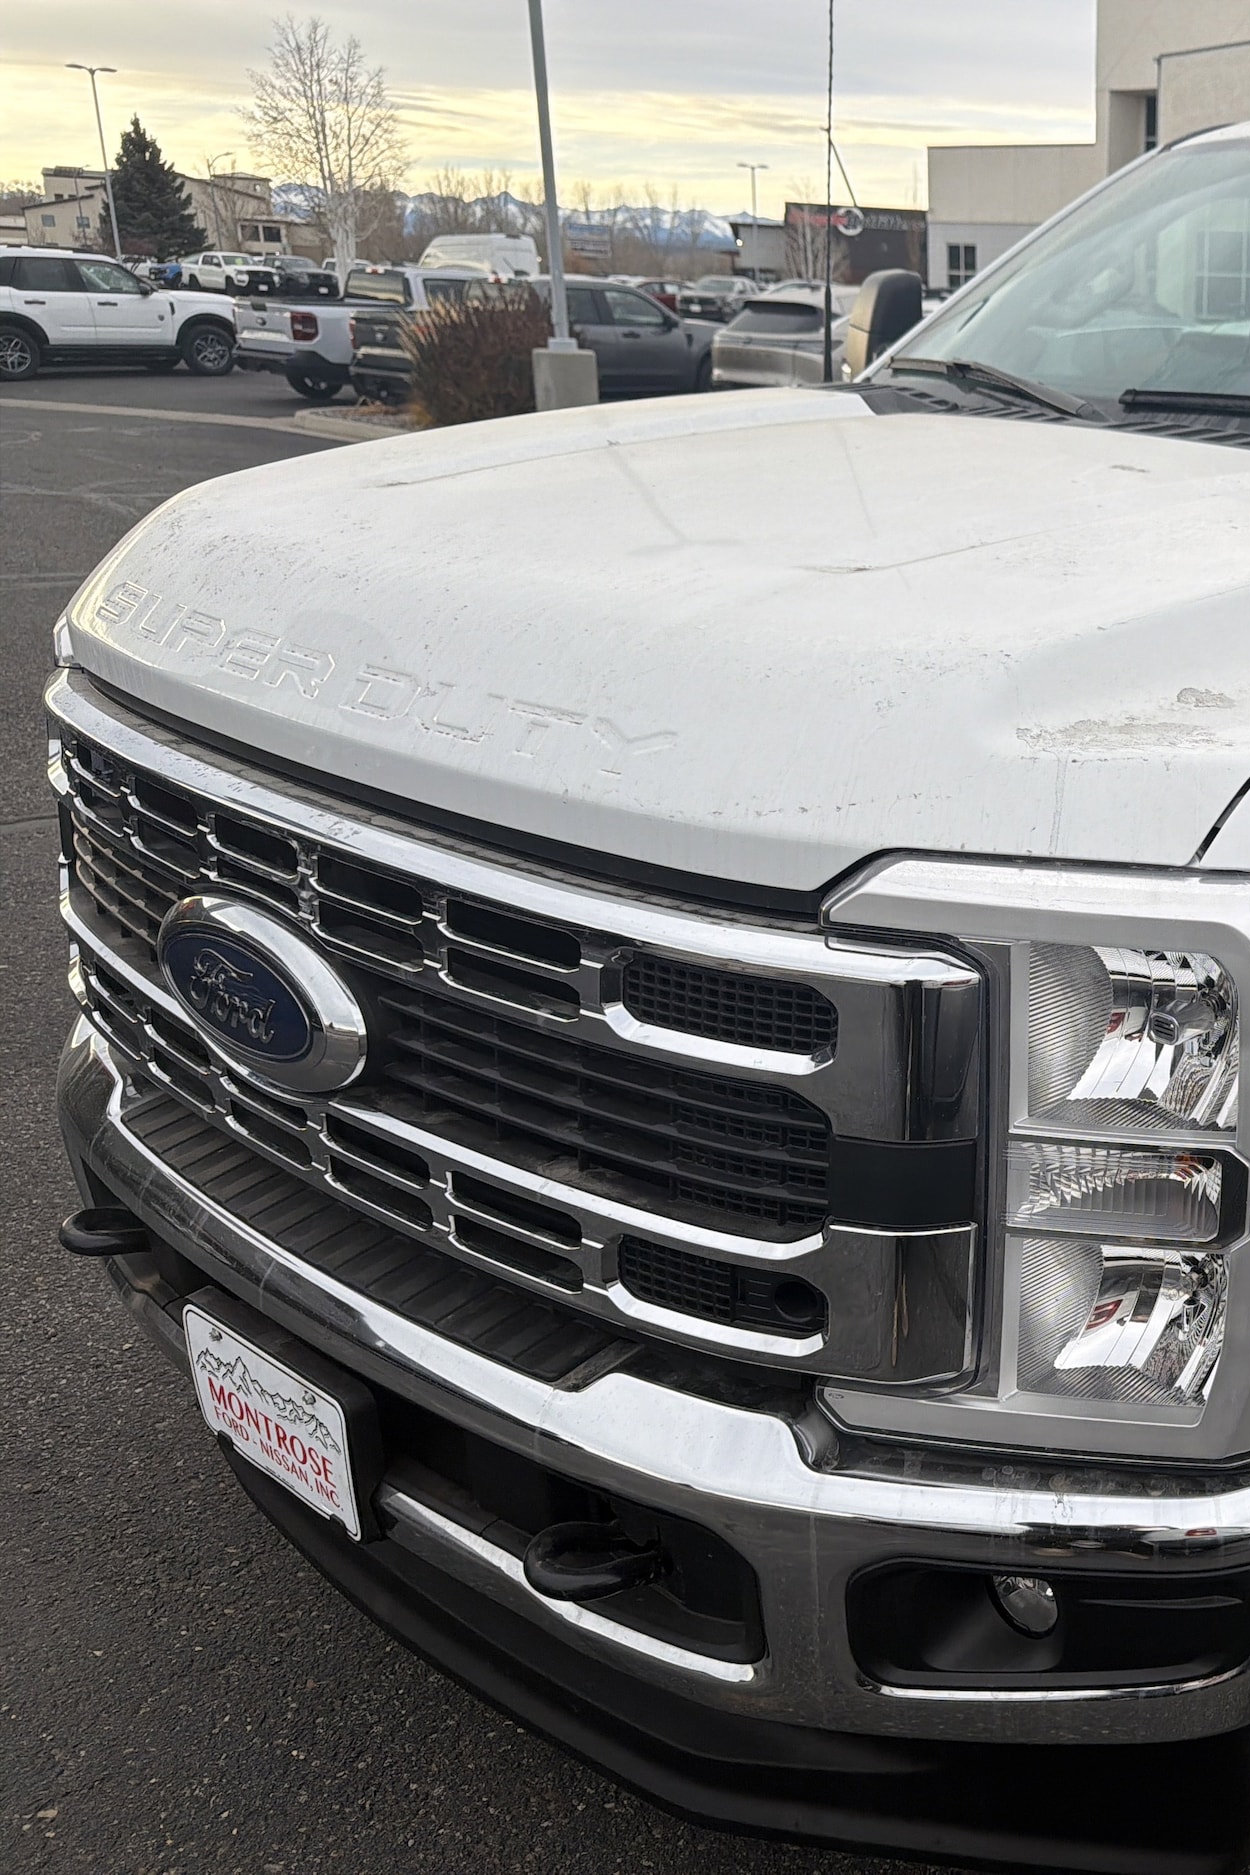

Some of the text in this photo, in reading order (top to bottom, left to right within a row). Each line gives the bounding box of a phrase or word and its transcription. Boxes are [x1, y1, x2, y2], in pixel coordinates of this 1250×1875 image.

[95, 580, 679, 776] SUPER DUTY
[189, 948, 276, 1044] Ford
[207, 1376, 337, 1488] MONTROSE
[214, 1404, 250, 1442] FORD
[260, 1438, 314, 1492] NISSAN,
[314, 1475, 345, 1512] INC.
